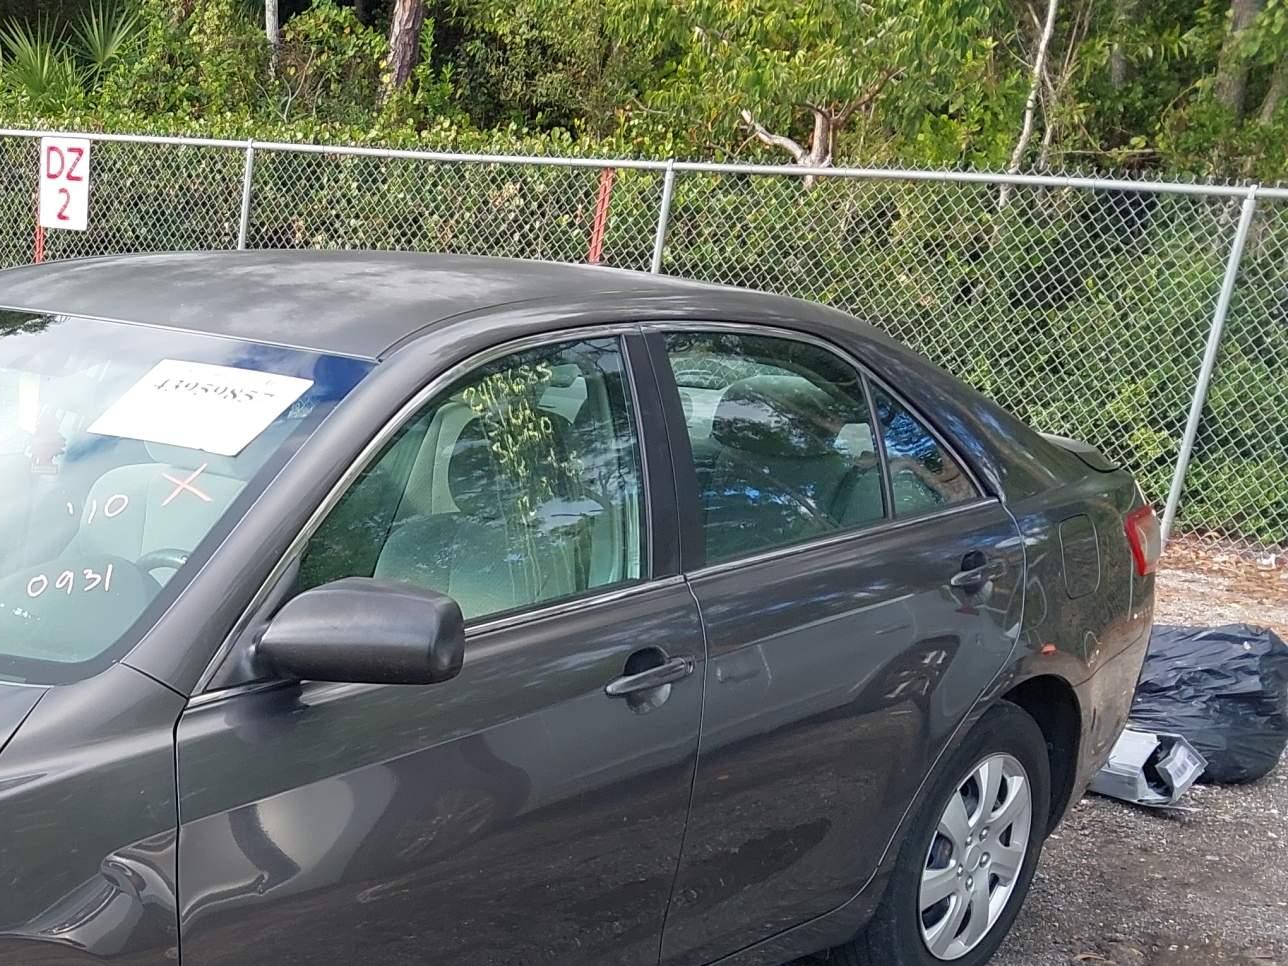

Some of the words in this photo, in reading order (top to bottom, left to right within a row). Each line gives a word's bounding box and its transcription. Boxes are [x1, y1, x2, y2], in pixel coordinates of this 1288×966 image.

[46, 146, 84, 181] DZ
[57, 188, 71, 220] 2
[26, 564, 113, 597] 0931
